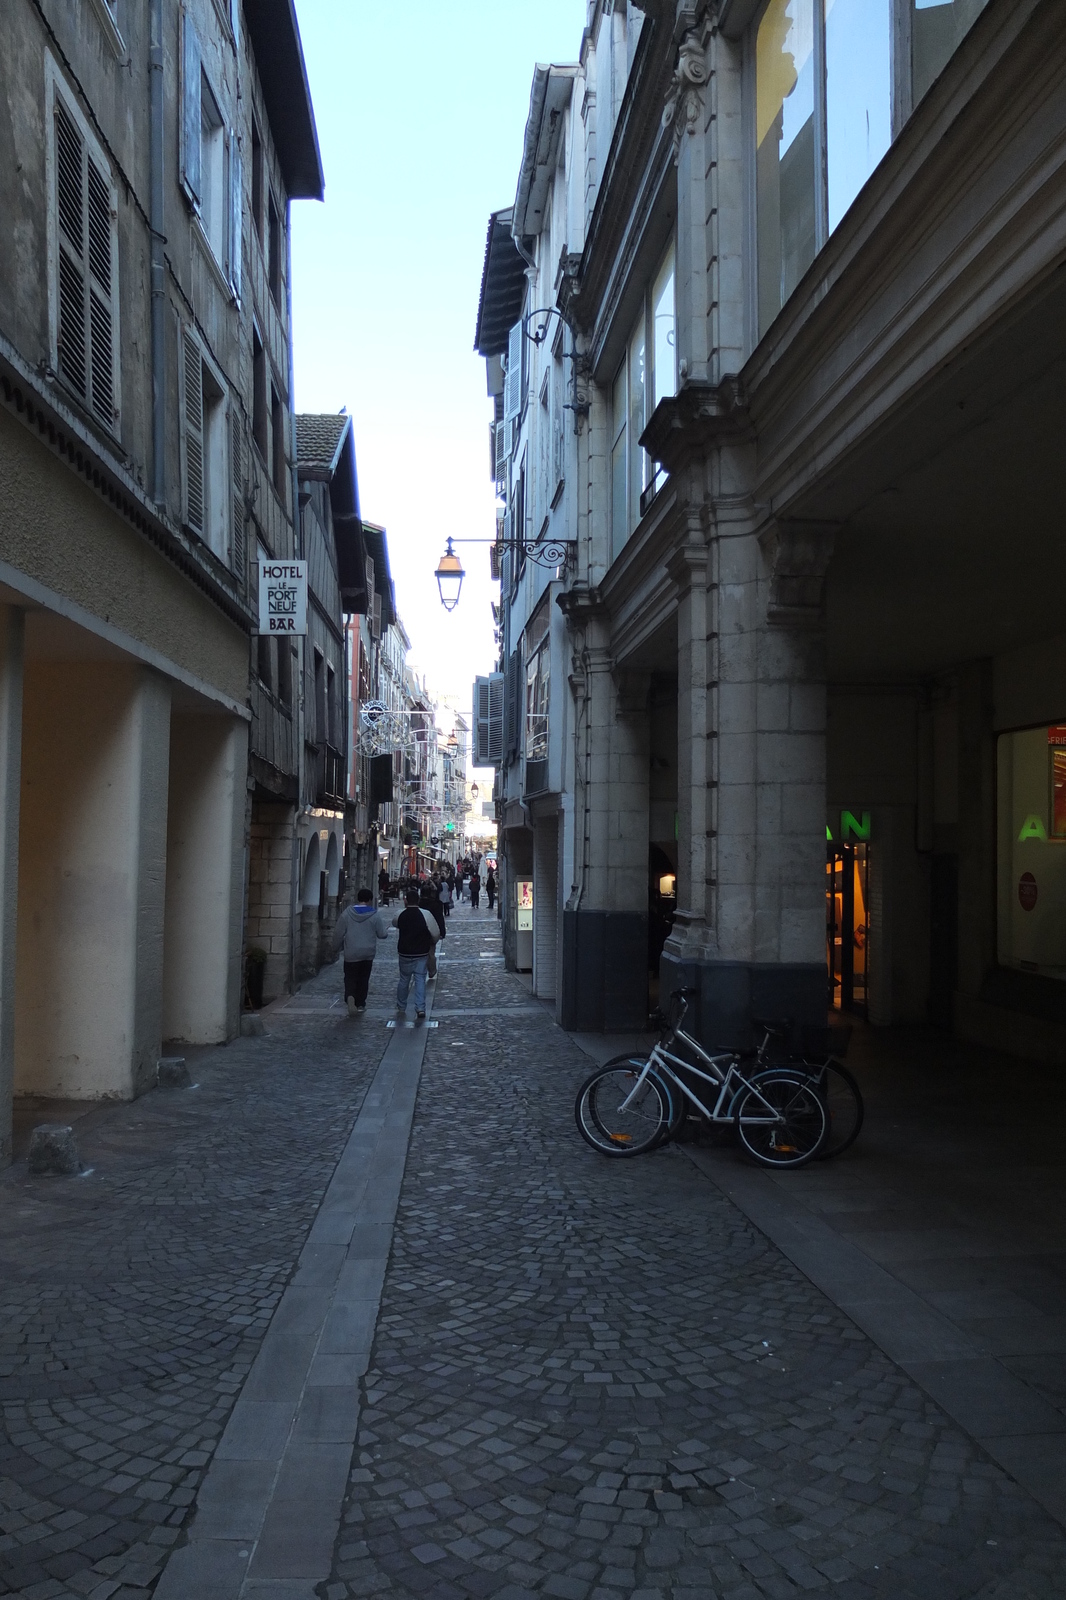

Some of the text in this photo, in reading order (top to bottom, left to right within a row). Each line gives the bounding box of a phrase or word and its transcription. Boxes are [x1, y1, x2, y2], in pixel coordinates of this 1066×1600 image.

[263, 566, 302, 578] HOTEL
[278, 582, 286, 590] LE
[268, 590, 297, 601] PORT
[268, 601, 297, 611] NEUF
[269, 618, 296, 631] BAR
